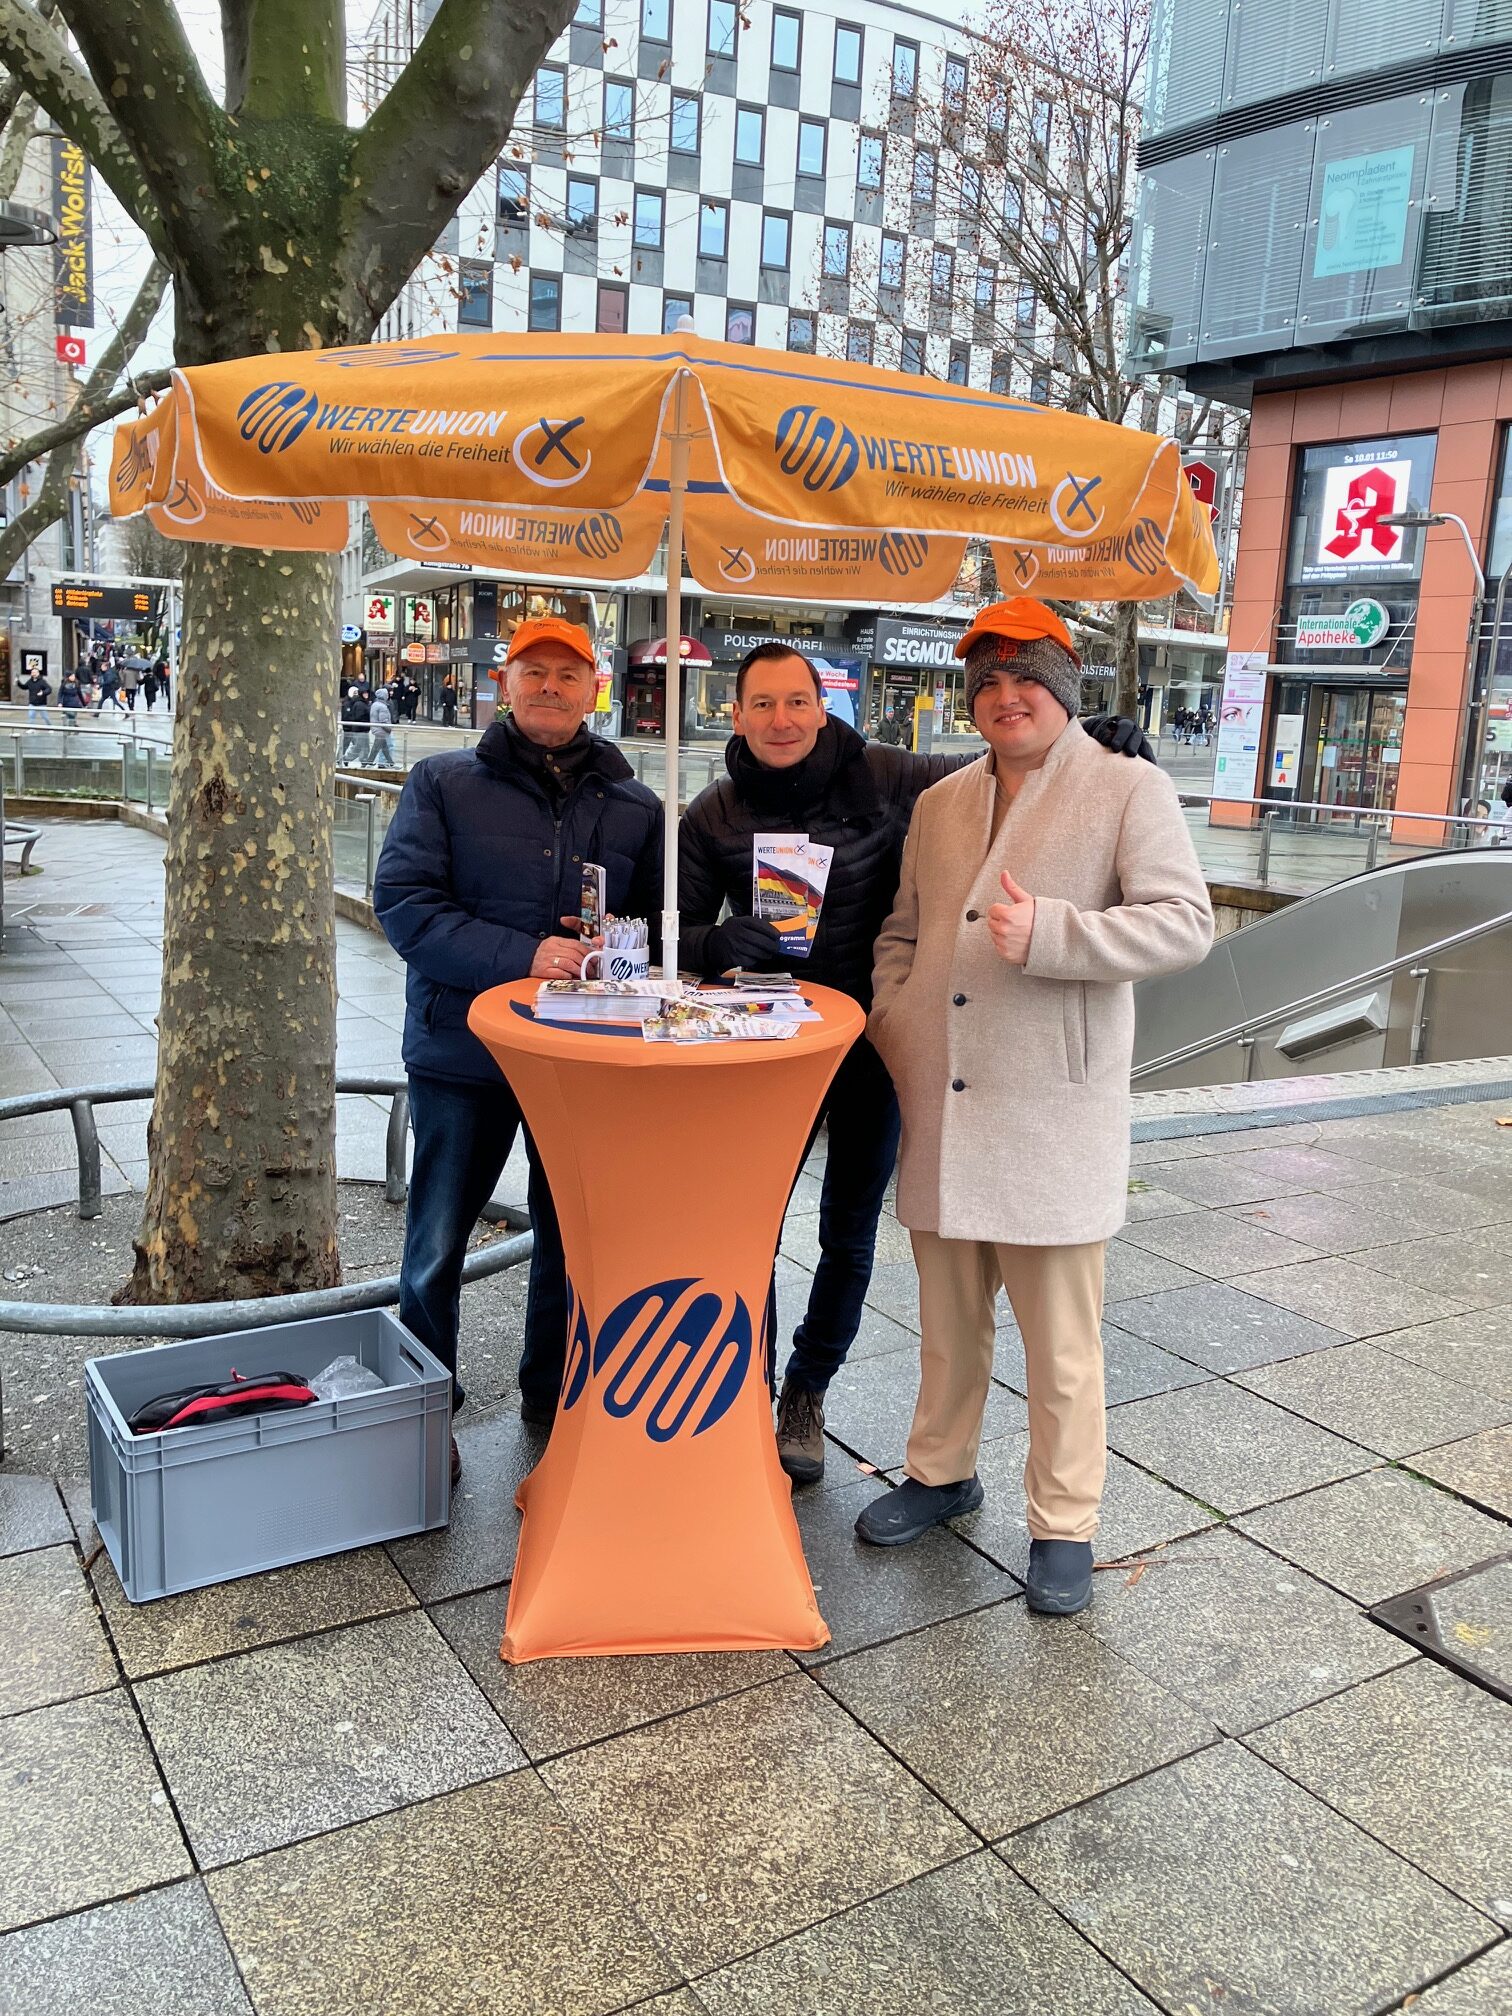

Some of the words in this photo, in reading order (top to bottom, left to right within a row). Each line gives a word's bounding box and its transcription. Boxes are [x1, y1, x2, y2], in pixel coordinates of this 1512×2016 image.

[1327, 160, 1396, 186] Neoimpladent
[61, 138, 85, 236] Wolfsk
[315, 403, 508, 437] WERTEUNION
[328, 437, 356, 454] Wir
[357, 439, 415, 457] wählen
[418, 440, 443, 458] die
[446, 441, 511, 463] Freiheit
[860, 434, 1038, 489] WERTEUNION
[884, 479, 911, 498] Wir
[911, 484, 966, 503] wählen
[968, 489, 993, 507] die
[994, 492, 1049, 514] Freiheit
[1299, 618, 1357, 630] Internationale
[1299, 630, 1356, 646] Apotheke
[1080, 664, 1116, 677] OLSTERM
[779, 935, 806, 943] ogramm
